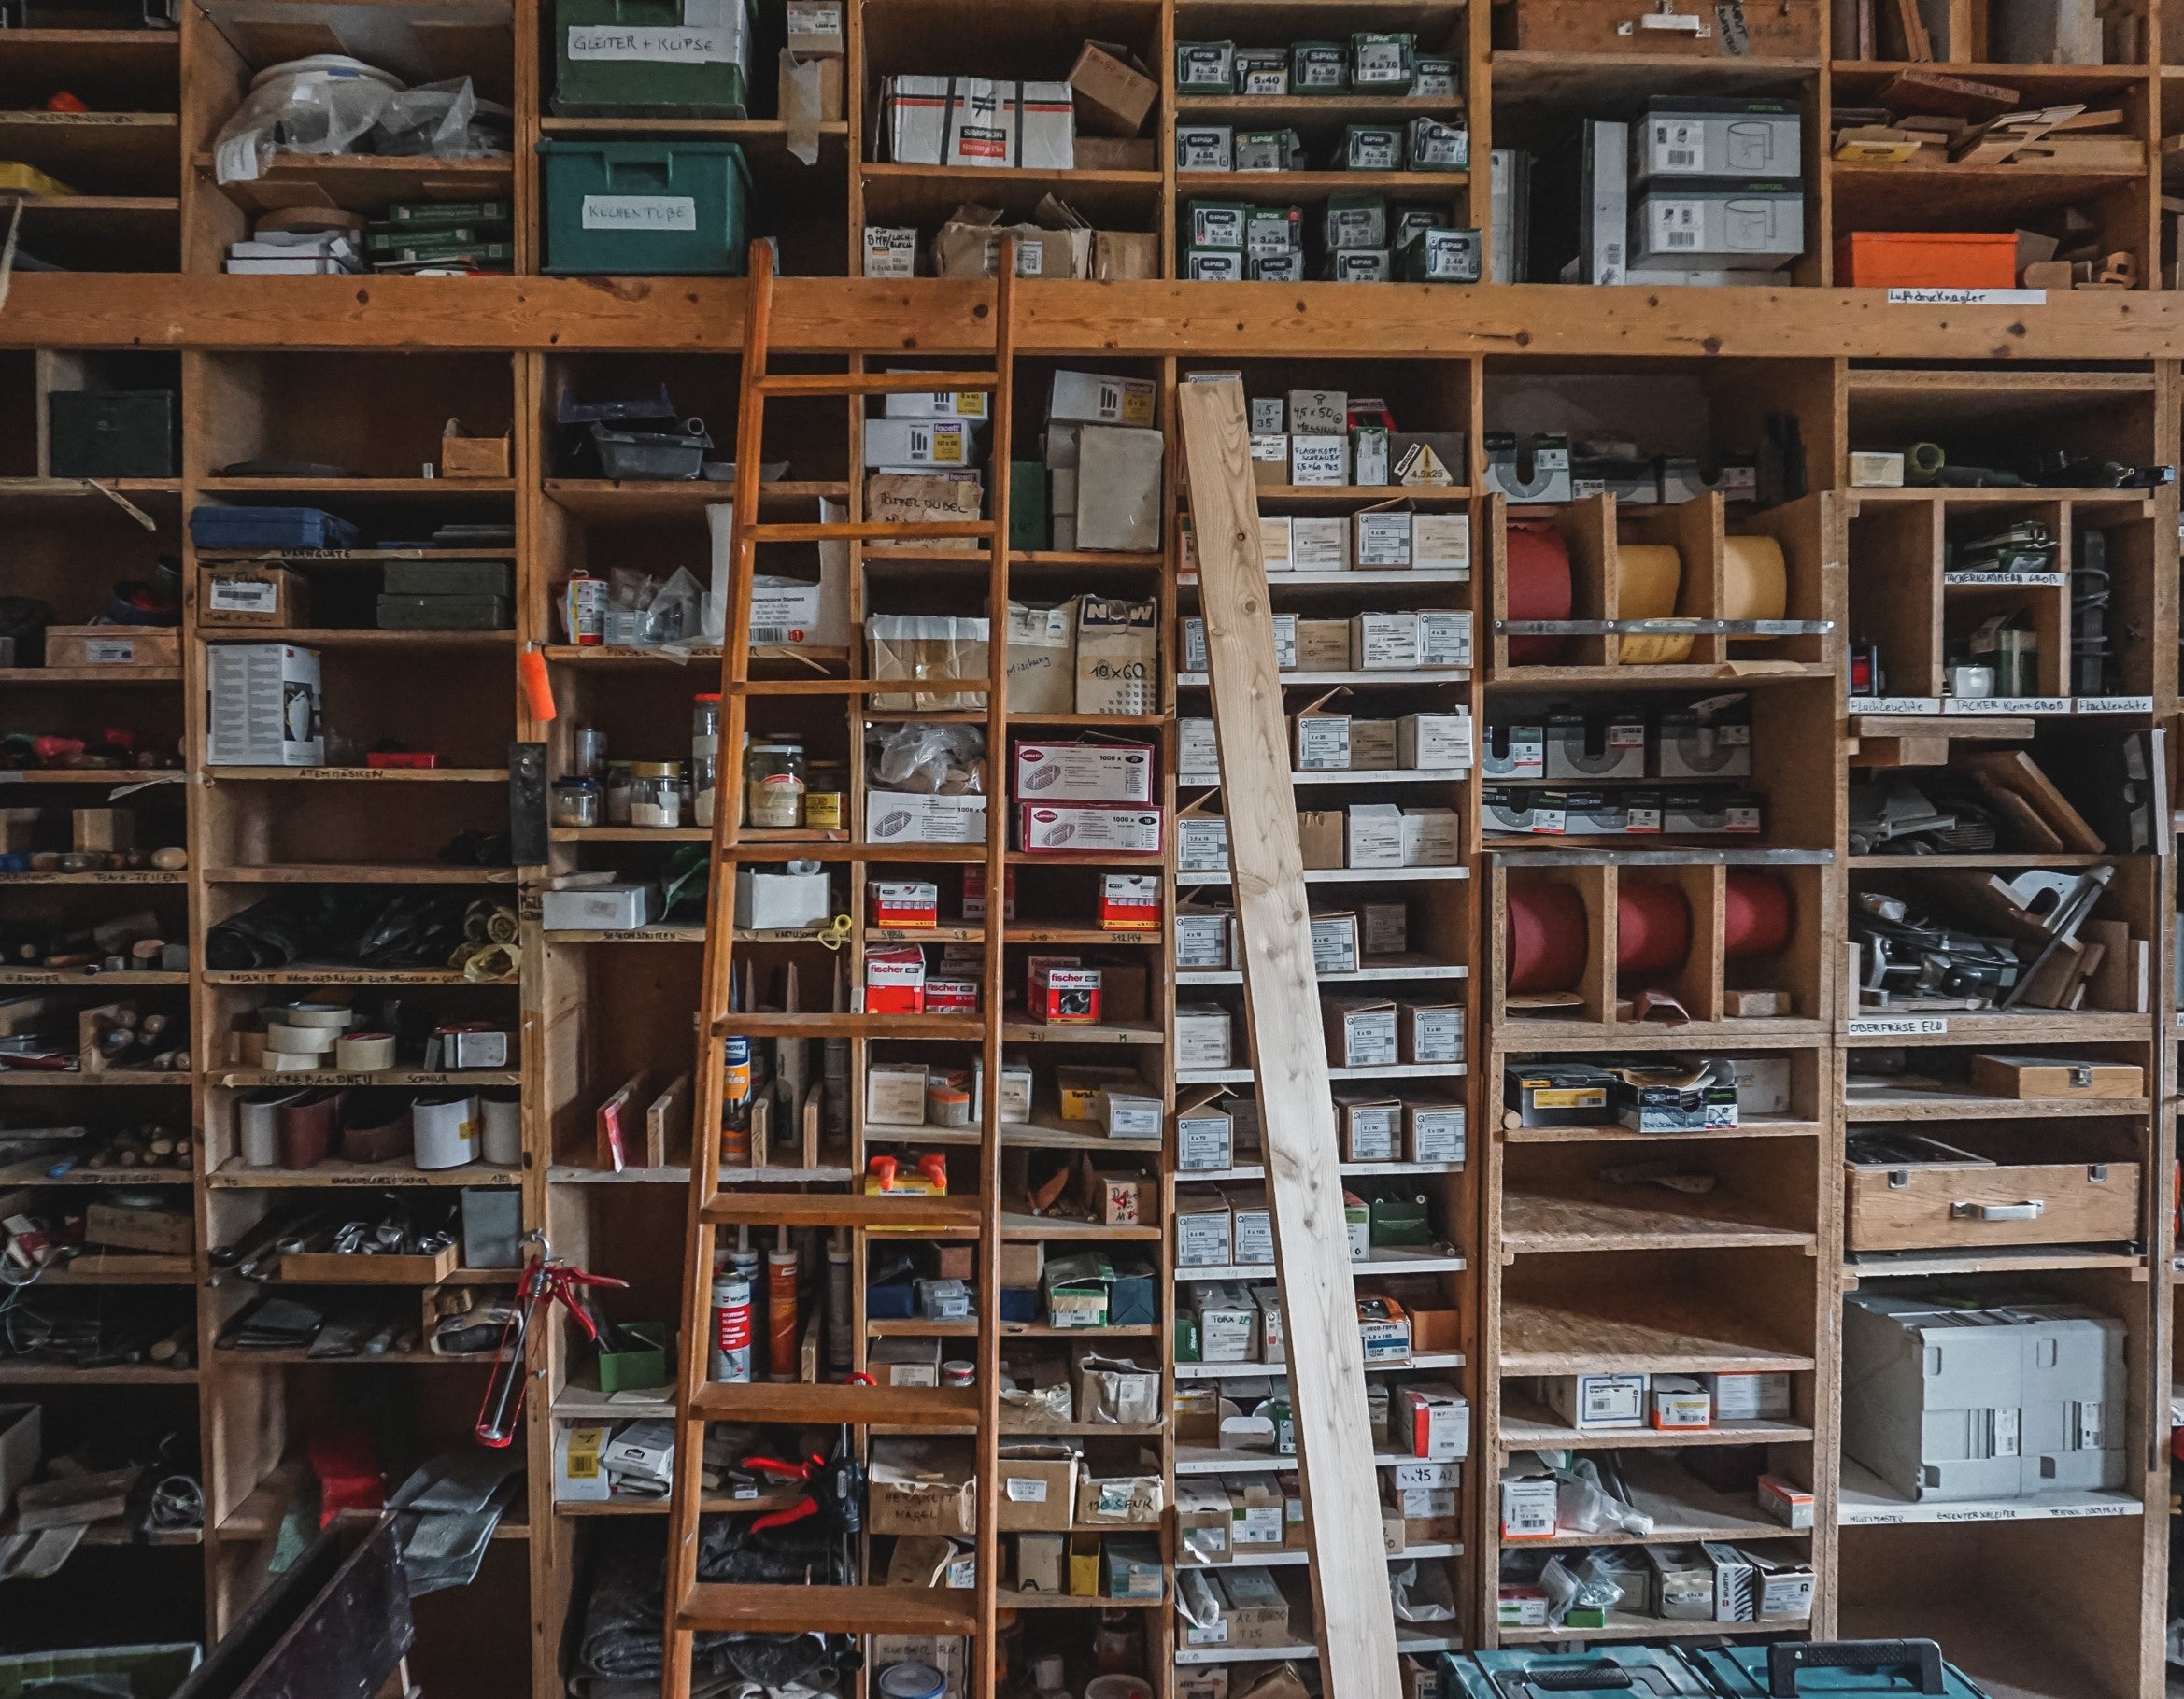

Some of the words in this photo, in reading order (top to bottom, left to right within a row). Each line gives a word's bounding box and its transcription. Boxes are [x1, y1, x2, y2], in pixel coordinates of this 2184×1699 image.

[574, 33, 638, 50] GLEITER
[642, 40, 652, 49] +
[658, 34, 715, 51] KLIPSE
[964, 129, 1003, 139] SIMPSON
[1318, 407, 1334, 418] 50
[1256, 418, 1274, 428] 35
[1953, 700, 1997, 711] TACKER
[871, 964, 903, 974] fischer
[1051, 973, 1084, 984] fischer
[927, 983, 959, 993] fischer
[1238, 1315, 1252, 1325] 20
